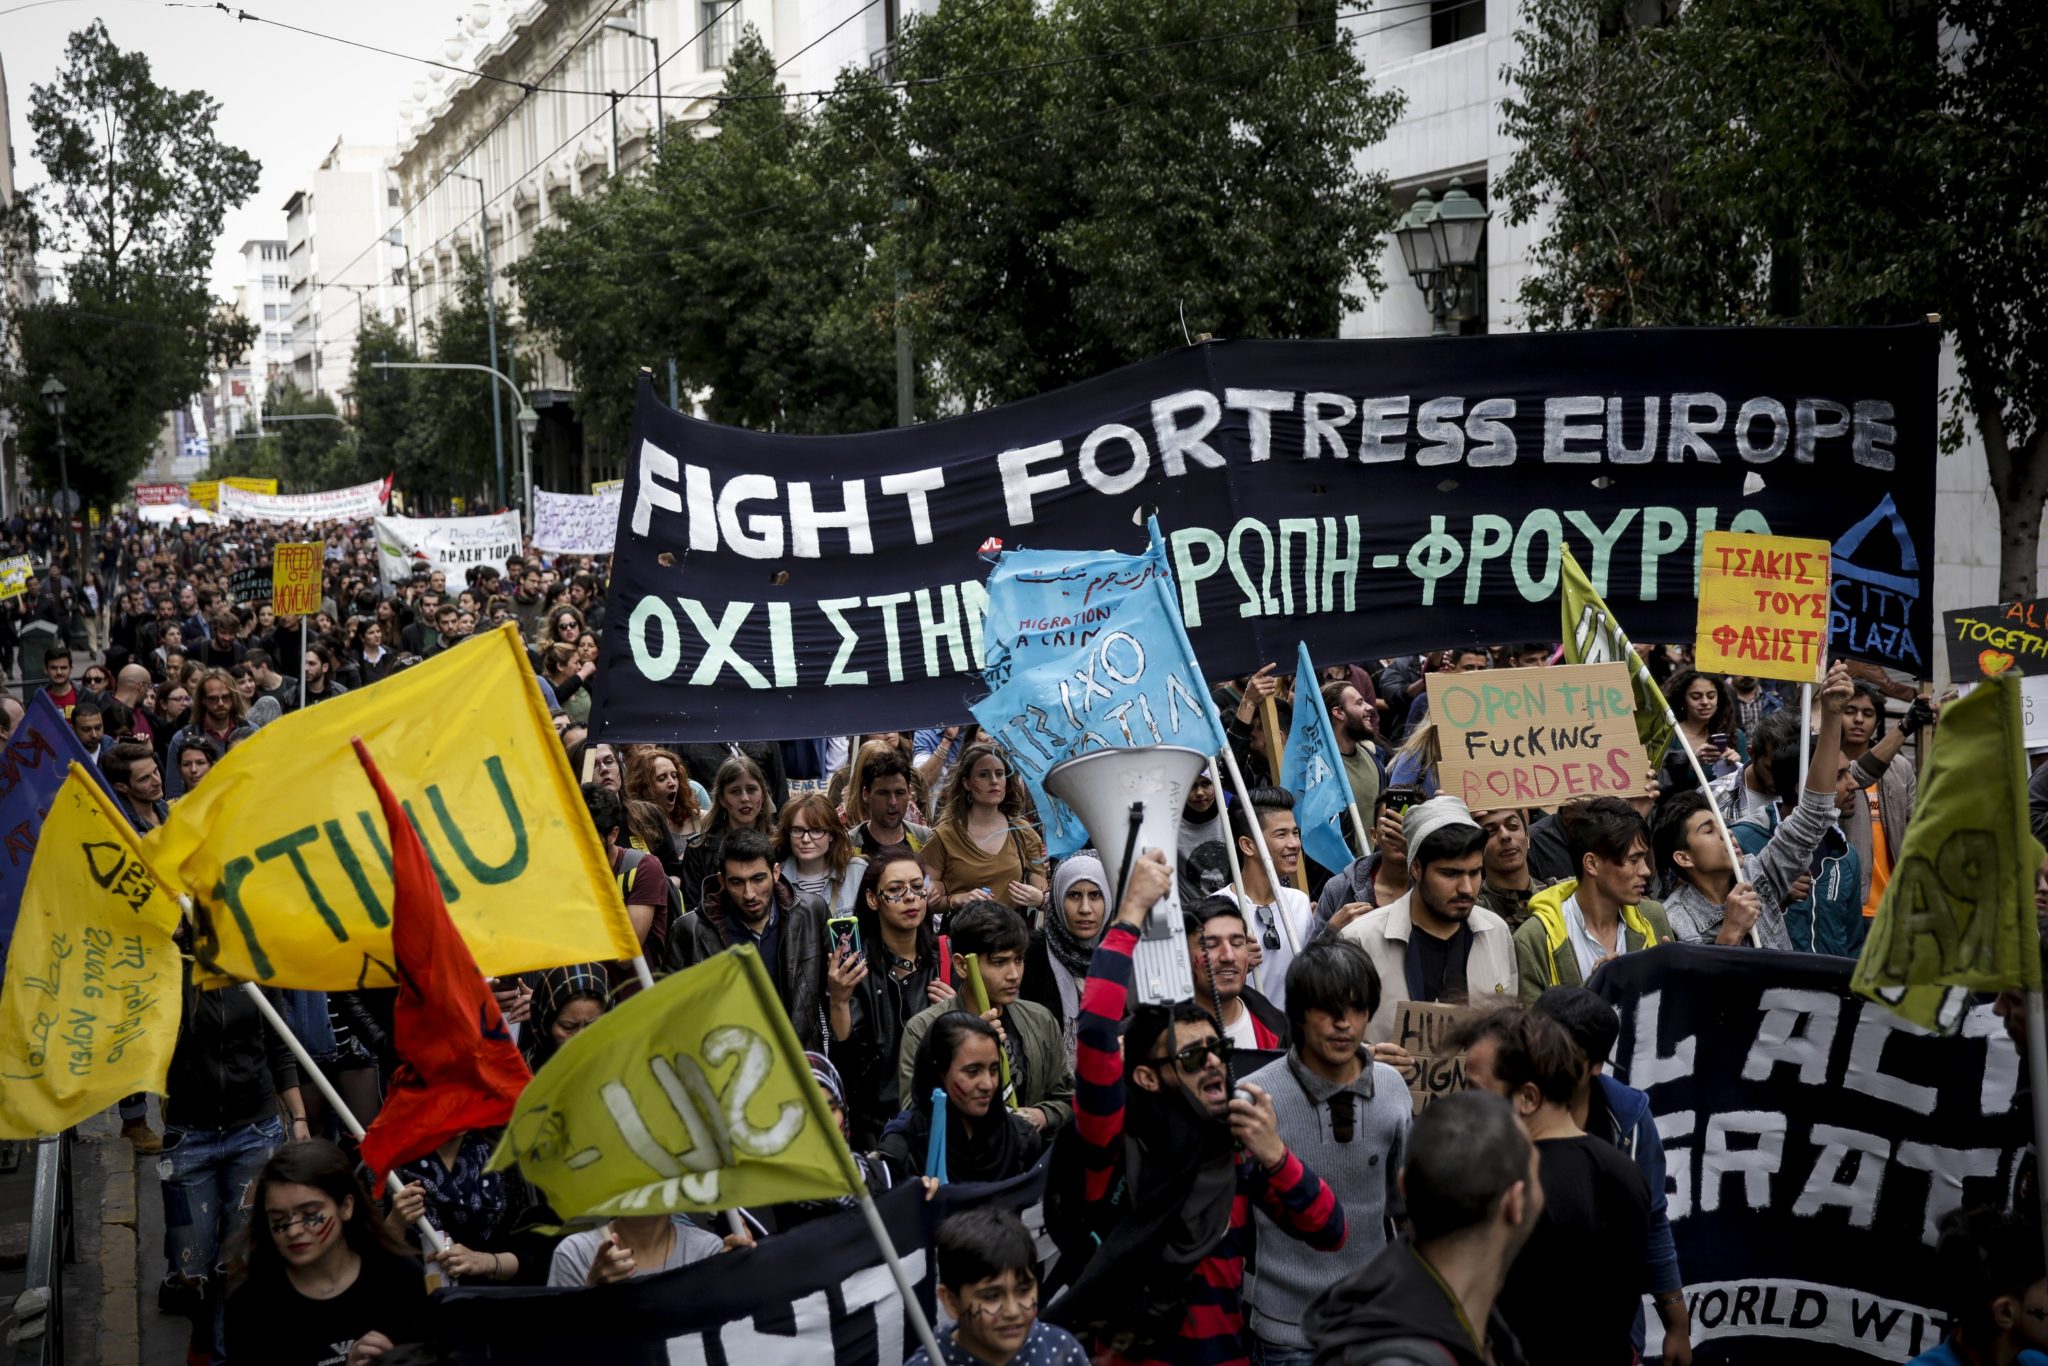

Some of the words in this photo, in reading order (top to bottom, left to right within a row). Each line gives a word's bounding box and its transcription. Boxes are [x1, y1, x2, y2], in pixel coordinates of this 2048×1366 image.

[631, 437, 944, 560] FIGHT
[998, 387, 1517, 526] FORTRESS
[1543, 392, 1897, 471] EUROPE
[288, 571, 310, 582] OF
[1019, 606, 1111, 631] MIGRATION
[1754, 590, 1826, 619] ΤΟΥΣ
[1831, 579, 1914, 625] CITY
[2006, 601, 2048, 629] AL
[628, 594, 798, 689] ΟΧΙ
[1016, 634, 1029, 649] A
[1829, 611, 1922, 666] PLAZA
[1462, 748, 1631, 807] BORDERS
